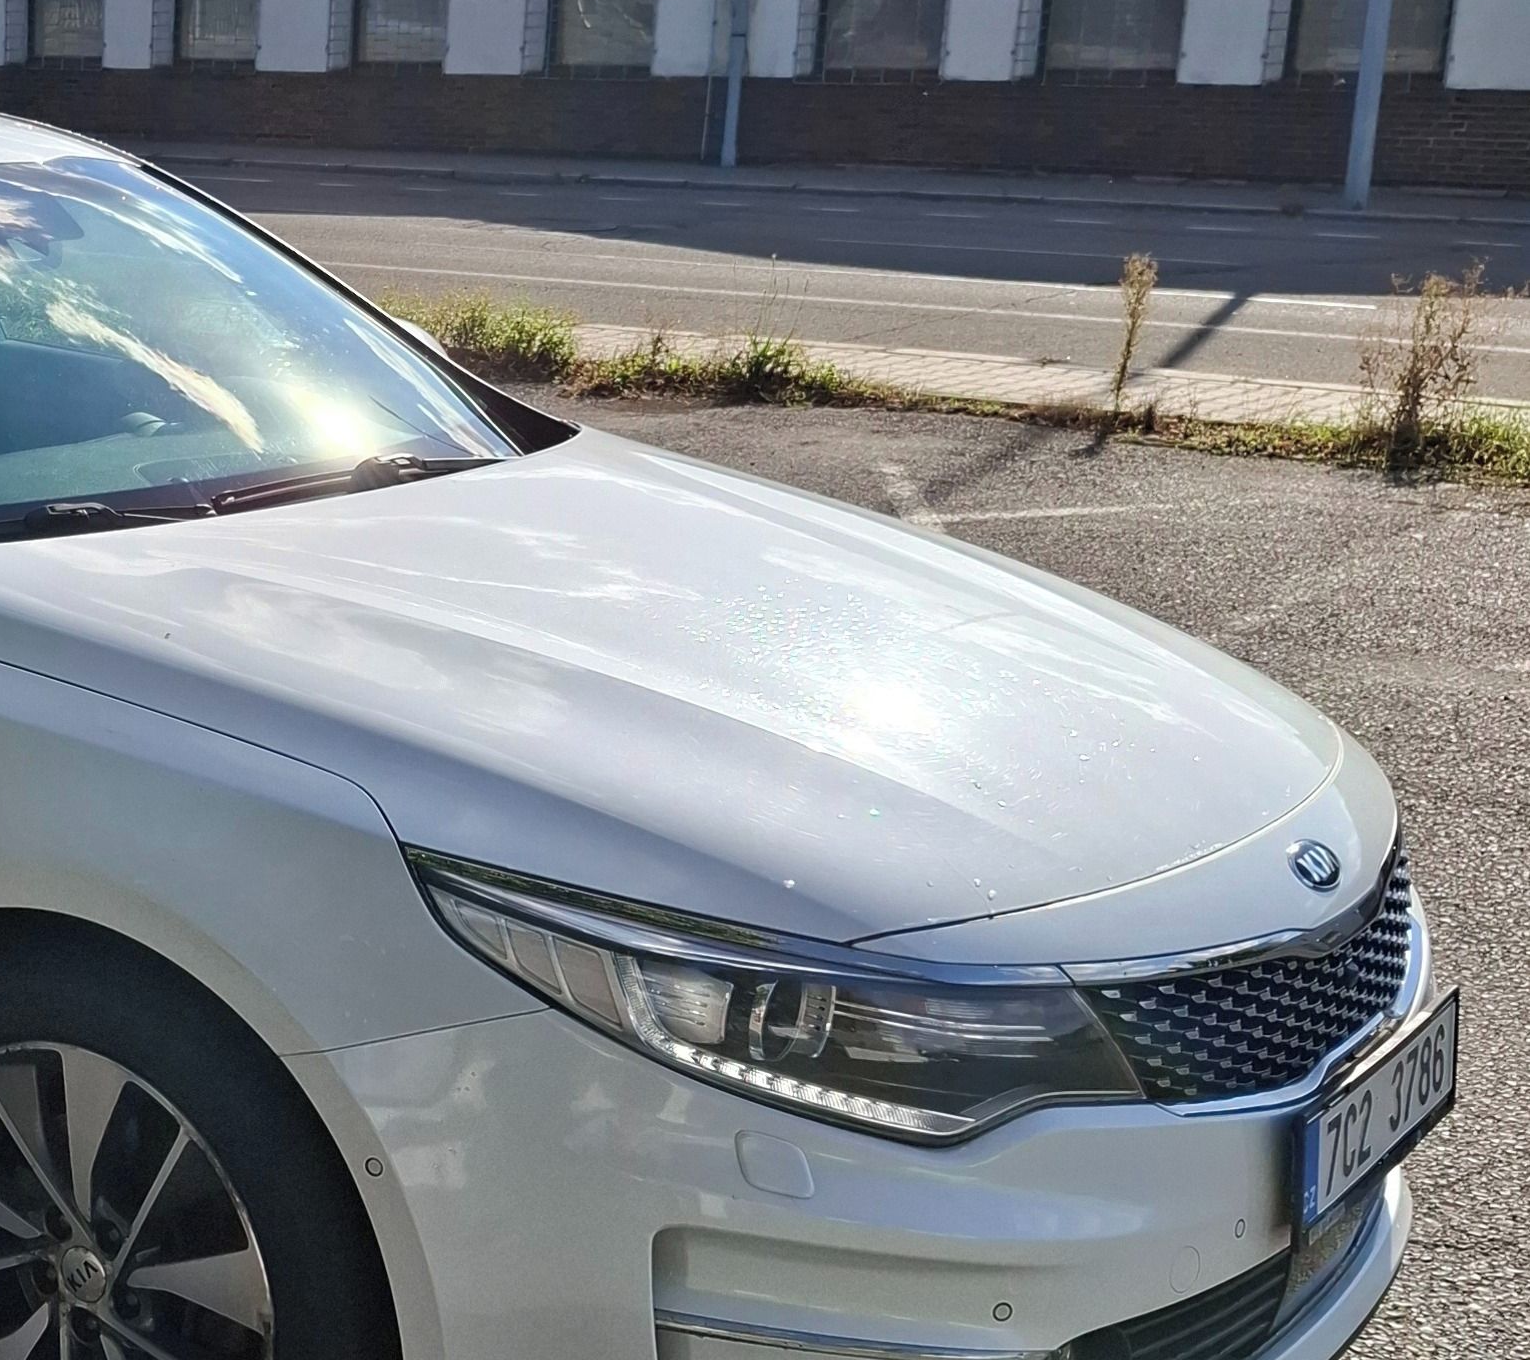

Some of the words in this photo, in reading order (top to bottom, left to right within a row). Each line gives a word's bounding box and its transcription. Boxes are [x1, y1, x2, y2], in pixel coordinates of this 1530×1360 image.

[1326, 1088, 1373, 1197] 7C2
[1389, 1023, 1446, 1133] 3786
[67, 1260, 98, 1293] KIA
